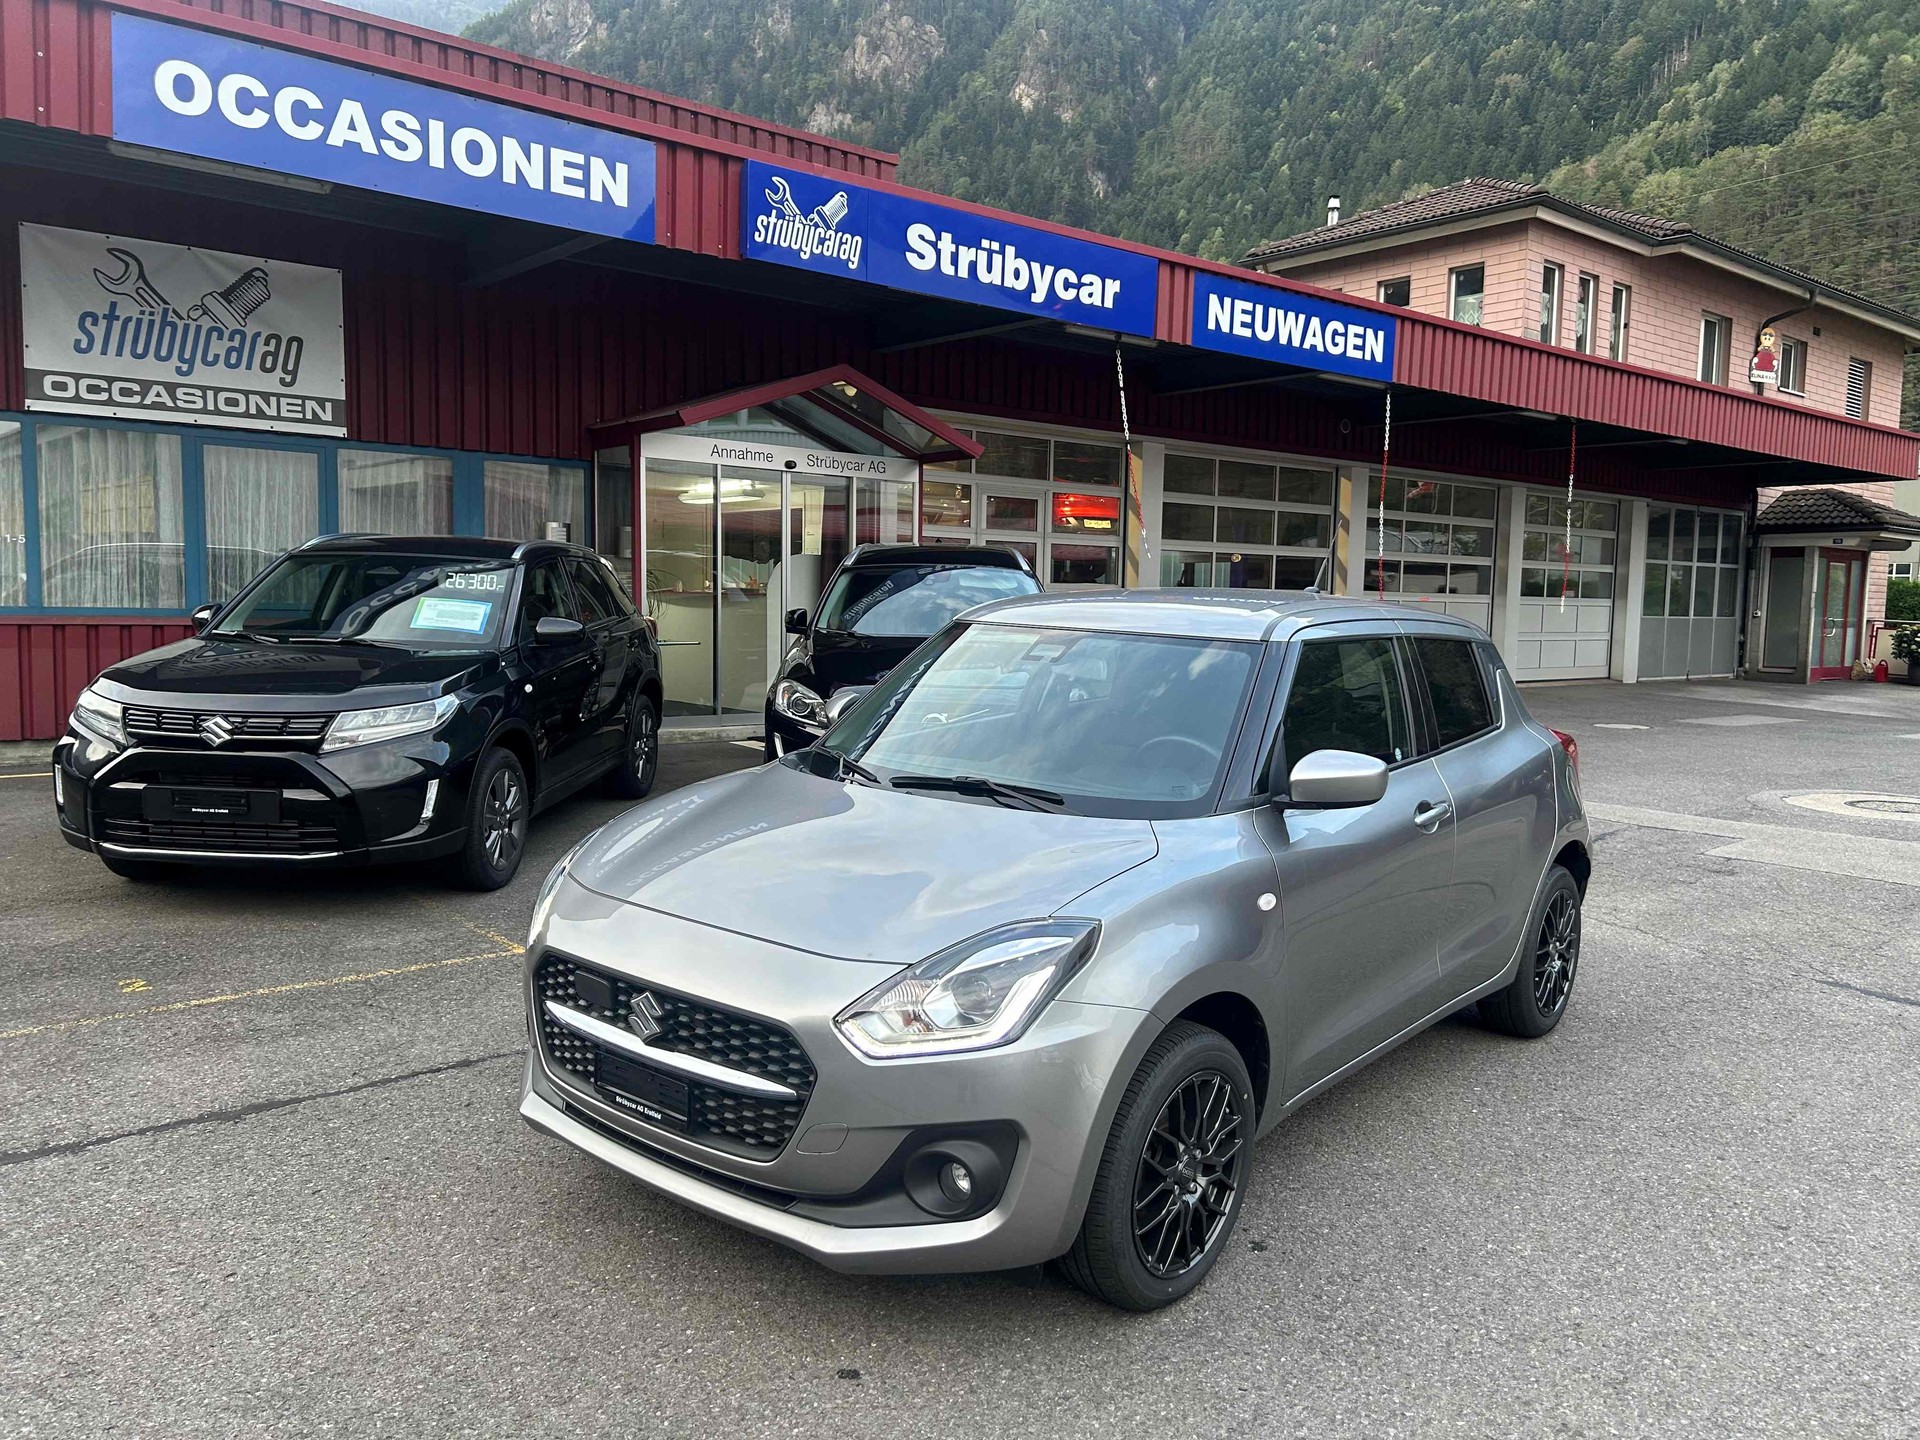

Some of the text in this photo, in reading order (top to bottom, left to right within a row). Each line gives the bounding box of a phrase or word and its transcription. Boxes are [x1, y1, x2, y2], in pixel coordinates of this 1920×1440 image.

[154, 58, 629, 207] OCCASIONEN
[754, 208, 862, 270] strübycarag
[904, 222, 1121, 309] Strübycar
[73, 300, 304, 388] strübycarag
[1207, 292, 1385, 364] NEUWAGEN
[42, 374, 333, 422] OCCASIONEN
[710, 444, 774, 463] Annahme
[806, 453, 886, 474] Strübycar AG
